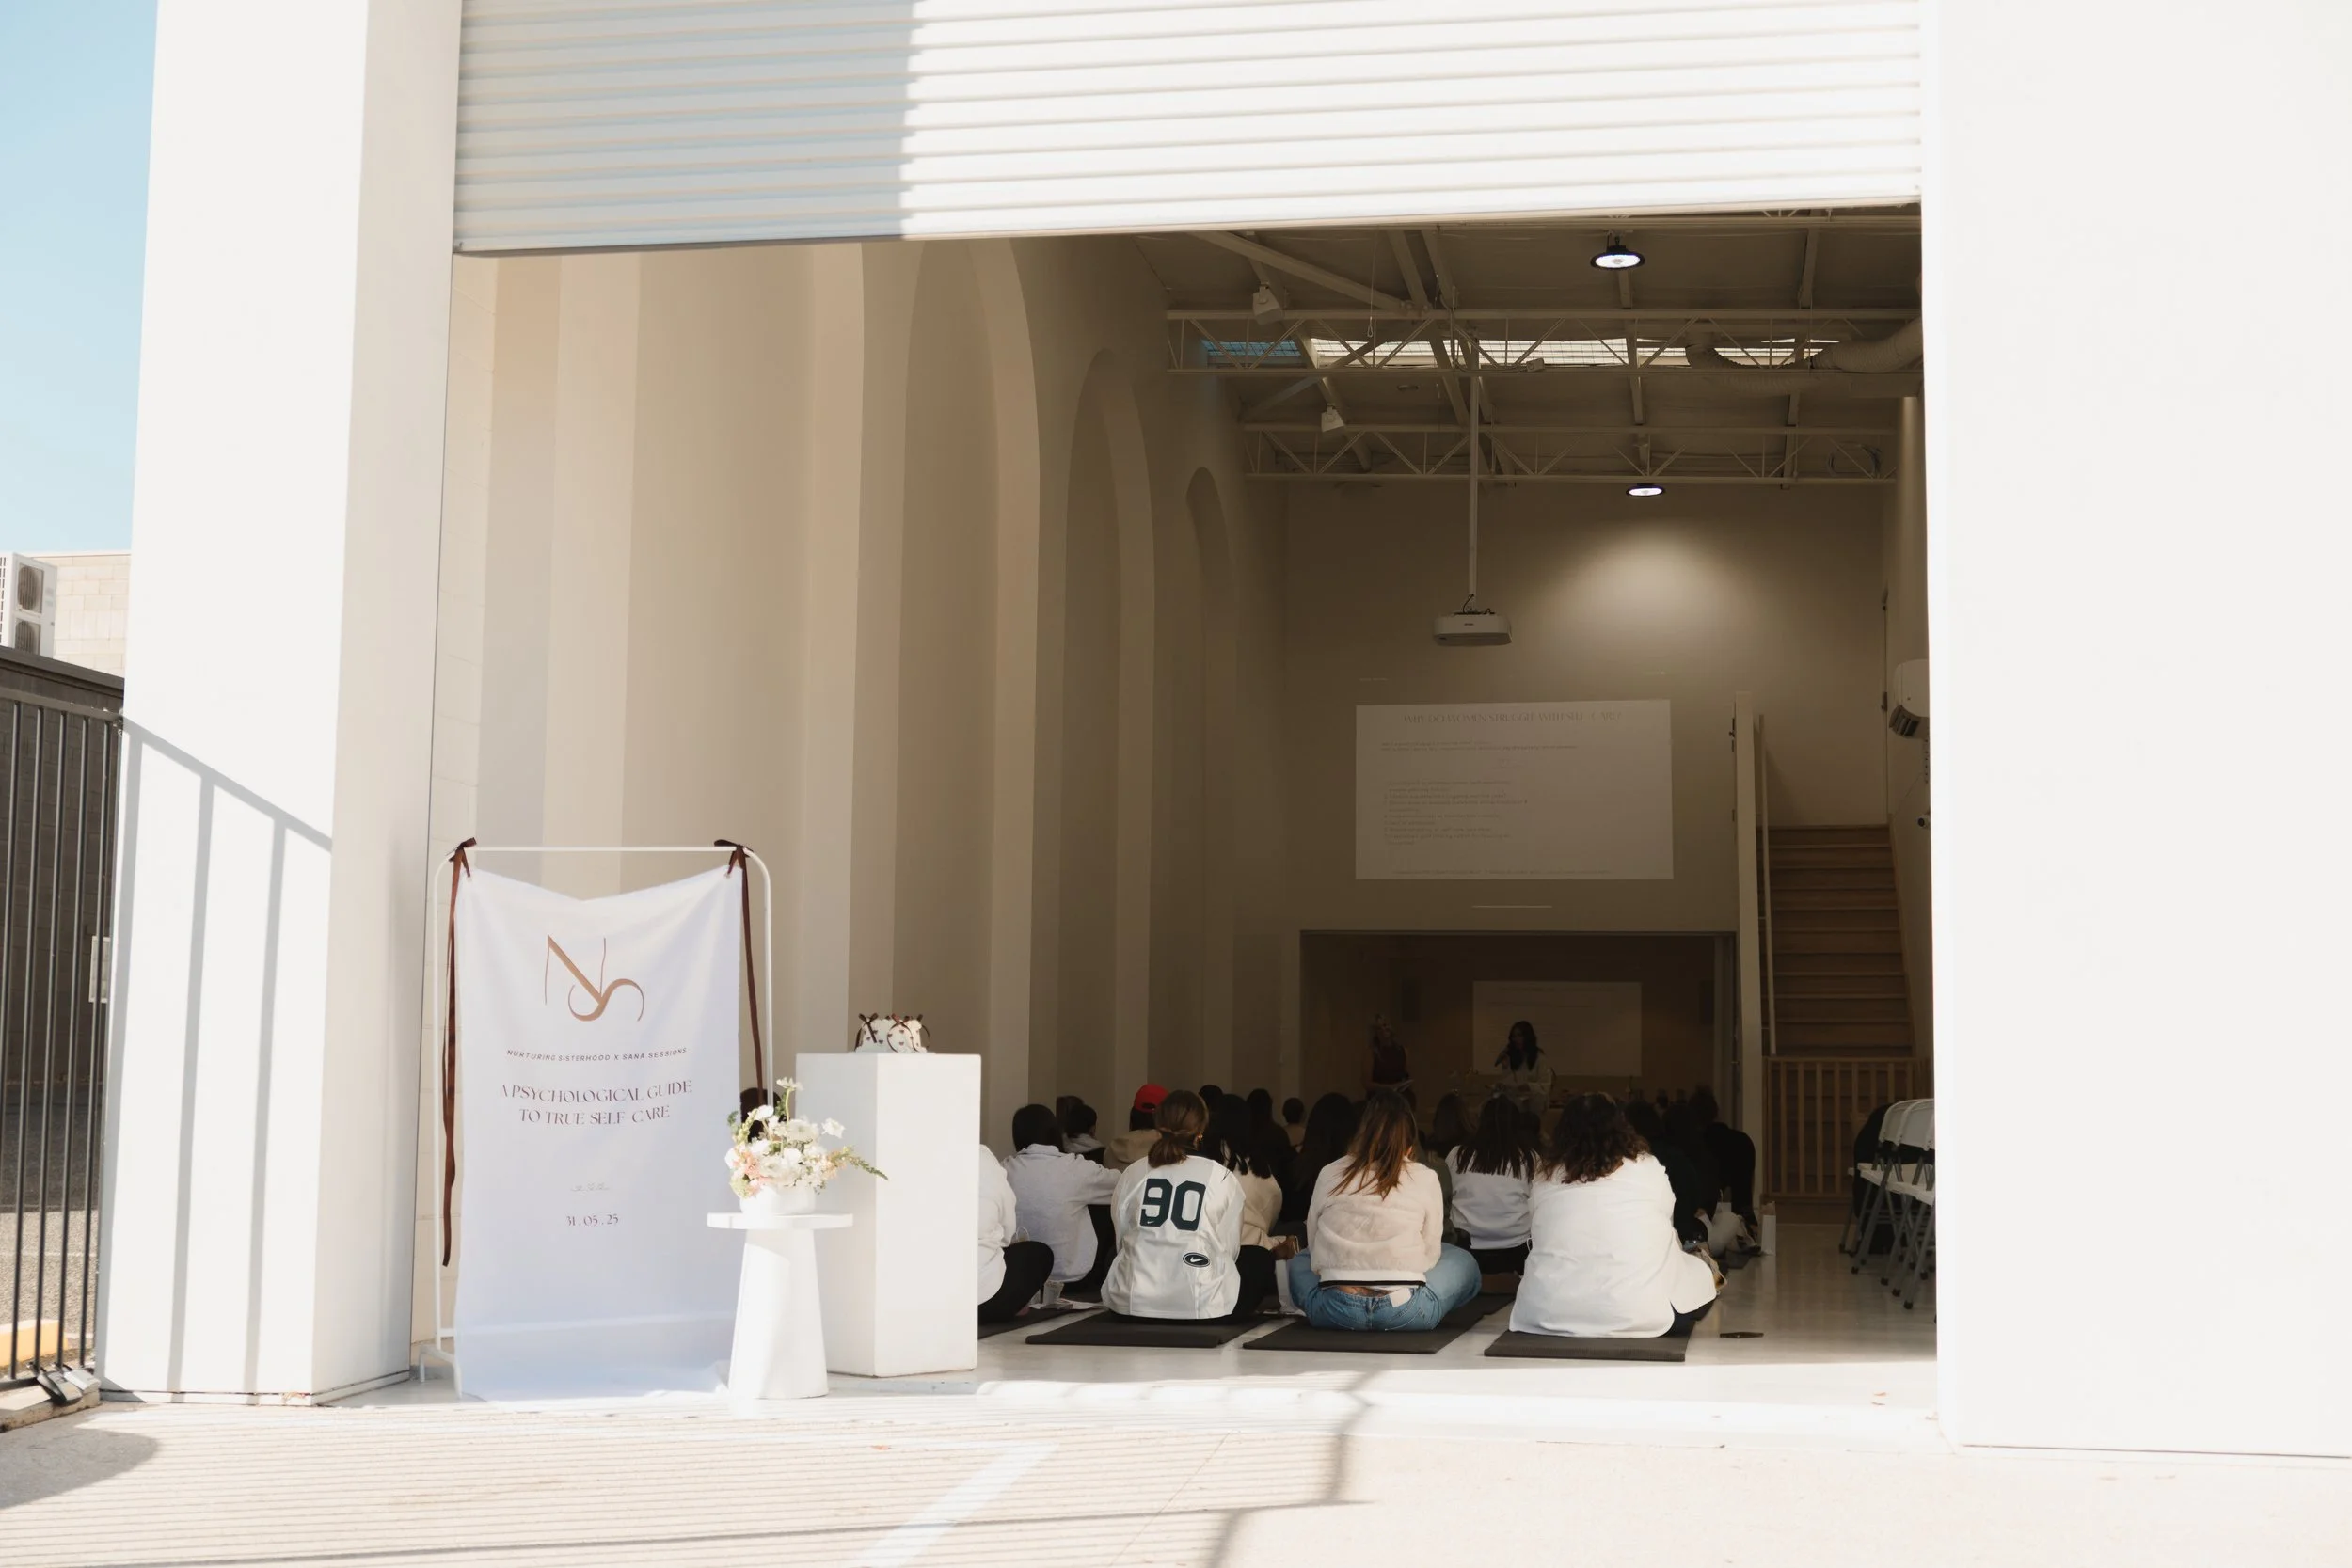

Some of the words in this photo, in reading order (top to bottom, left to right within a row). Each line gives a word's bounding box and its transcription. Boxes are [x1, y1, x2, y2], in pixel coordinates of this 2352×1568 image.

[506, 1049, 557, 1062] NURTURING
[558, 1053, 611, 1062] SISTERHOOD
[622, 1053, 645, 1061] SANA
[647, 1047, 687, 1059] SESSIONS
[512, 1085, 644, 1103] PSYCHOLOGICAL
[646, 1079, 693, 1100] GUIDE
[519, 1108, 542, 1123] TO
[545, 1111, 586, 1125] TRUE
[589, 1111, 626, 1125] SELF
[631, 1104, 671, 1123] CARE
[1139, 1178, 1206, 1231] 90
